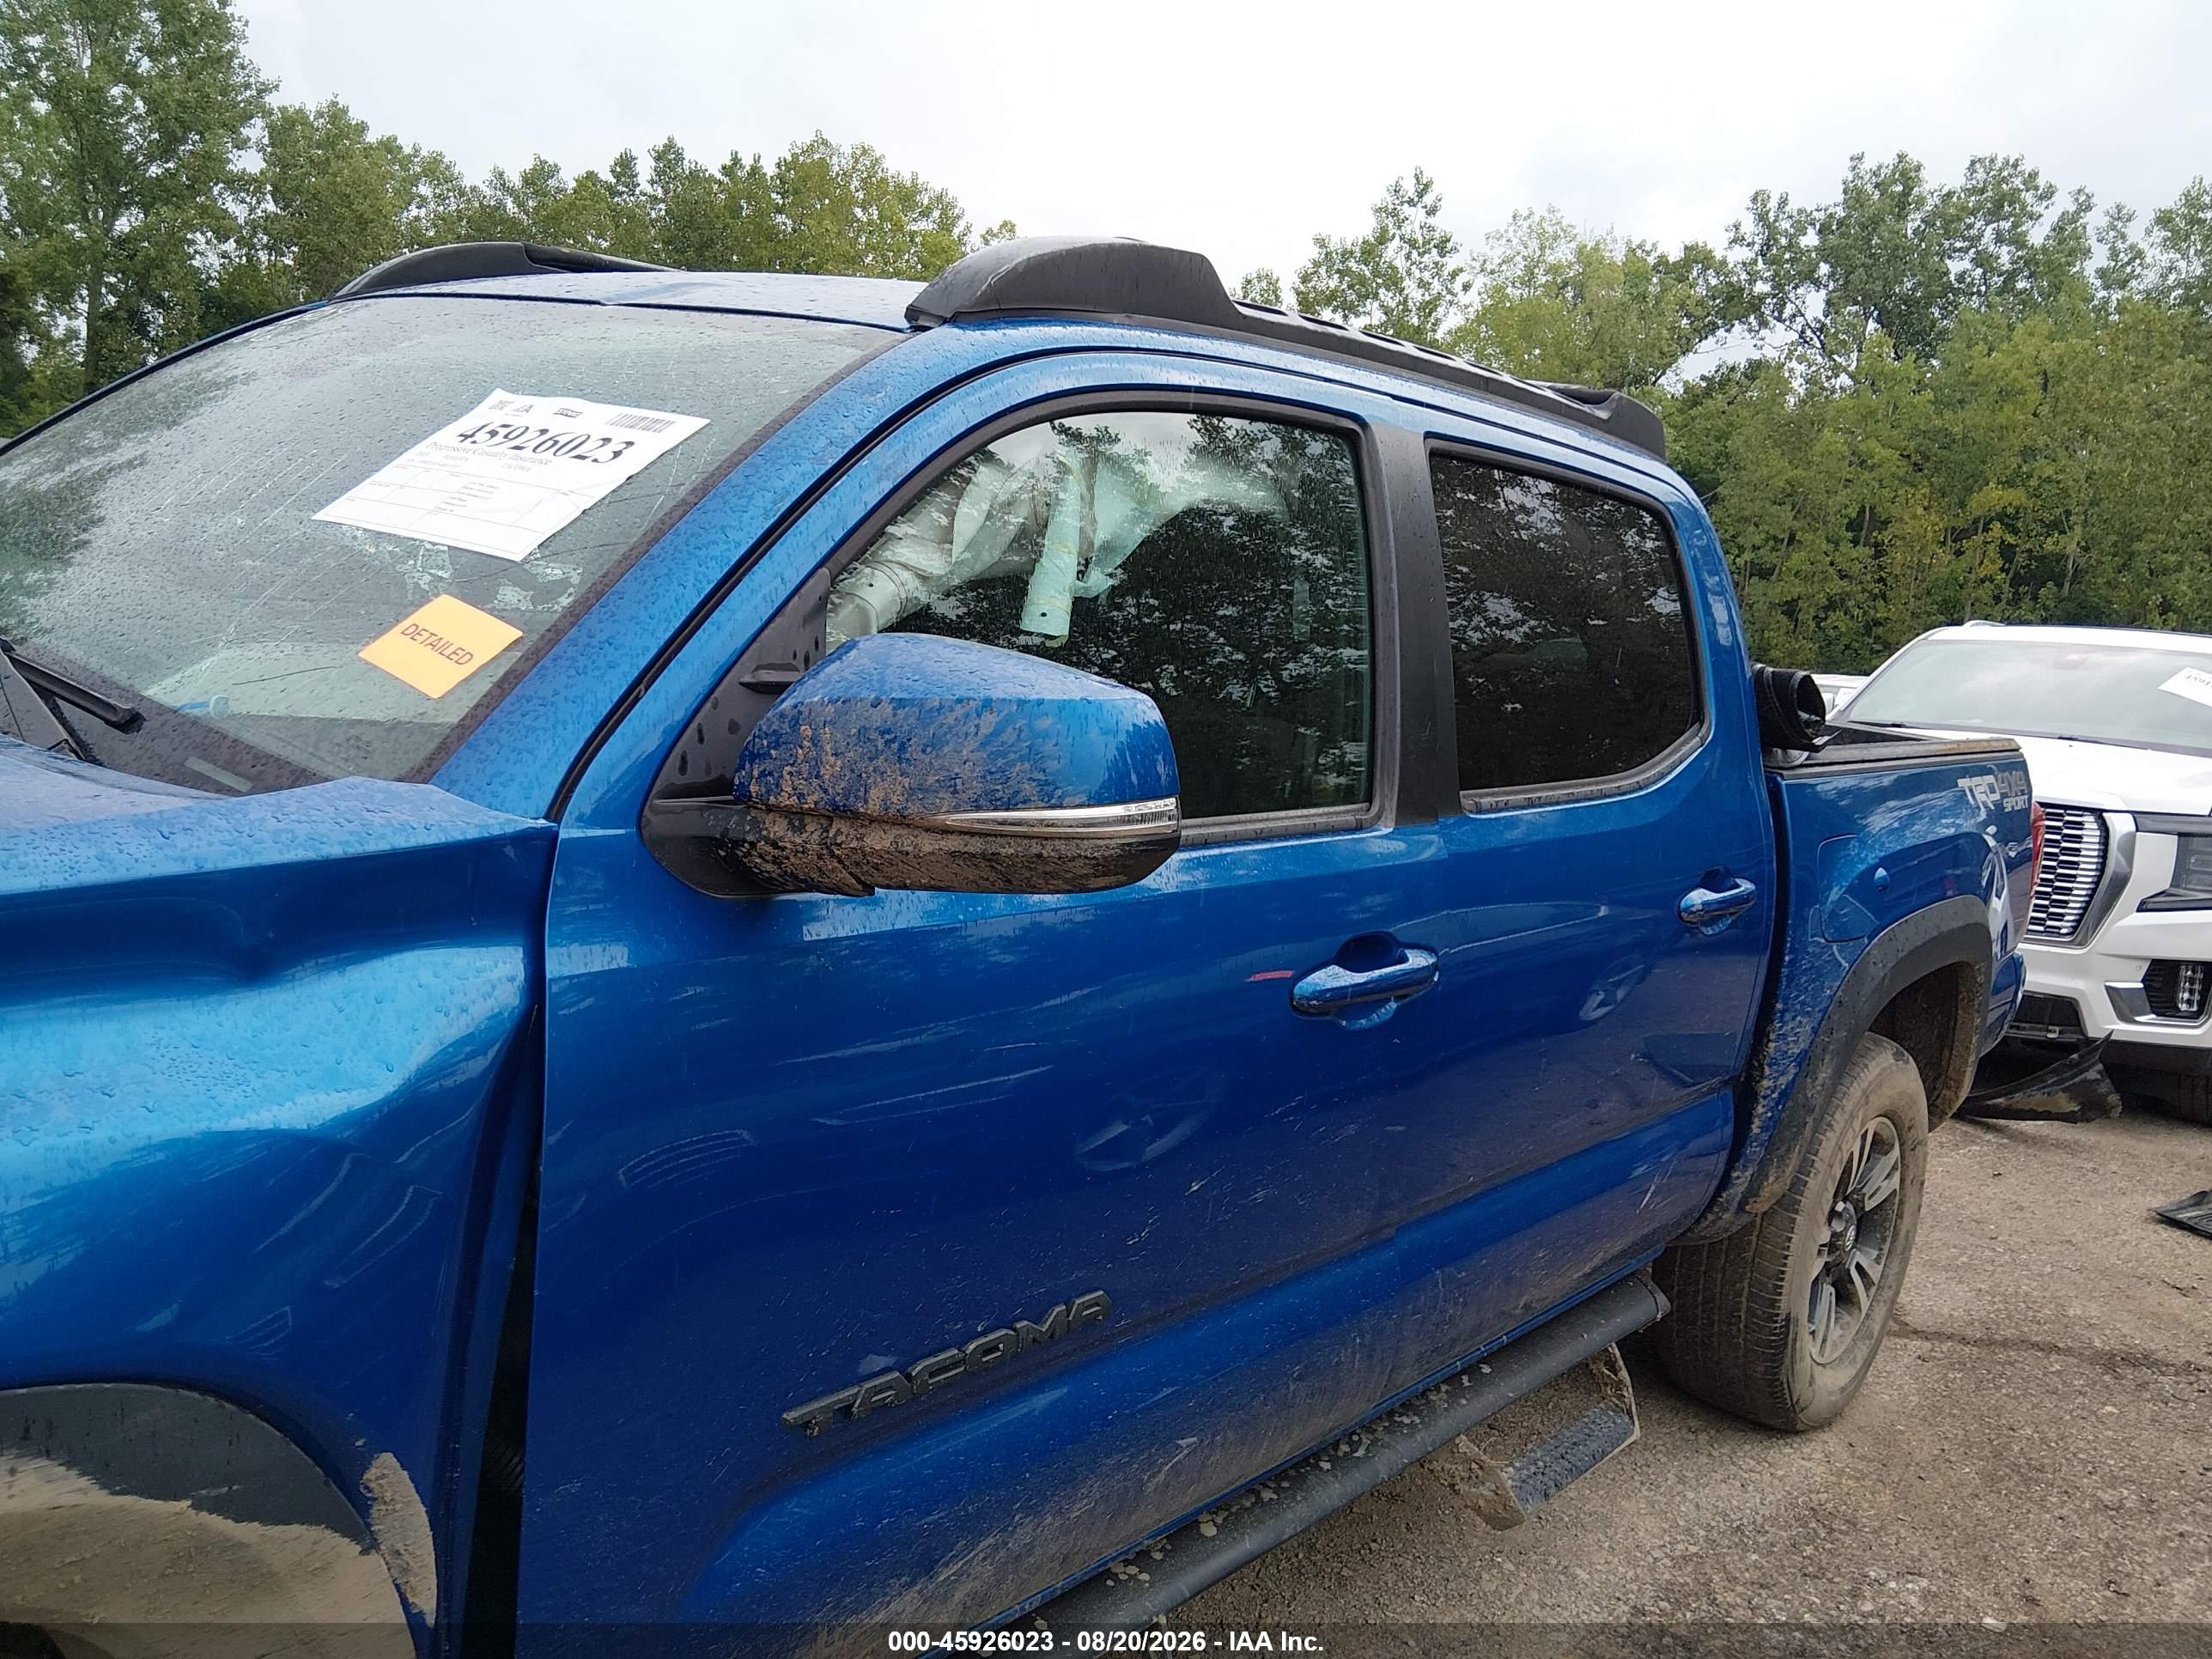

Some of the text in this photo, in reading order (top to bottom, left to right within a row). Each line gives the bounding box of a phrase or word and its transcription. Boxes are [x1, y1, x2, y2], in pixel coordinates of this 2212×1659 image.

[457, 421, 635, 464] 45926023
[400, 623, 474, 665] DETAILED
[1957, 775, 2002, 811] TRD
[2003, 794, 2029, 813] SPORT
[781, 1290, 1114, 1437] TACOMA
